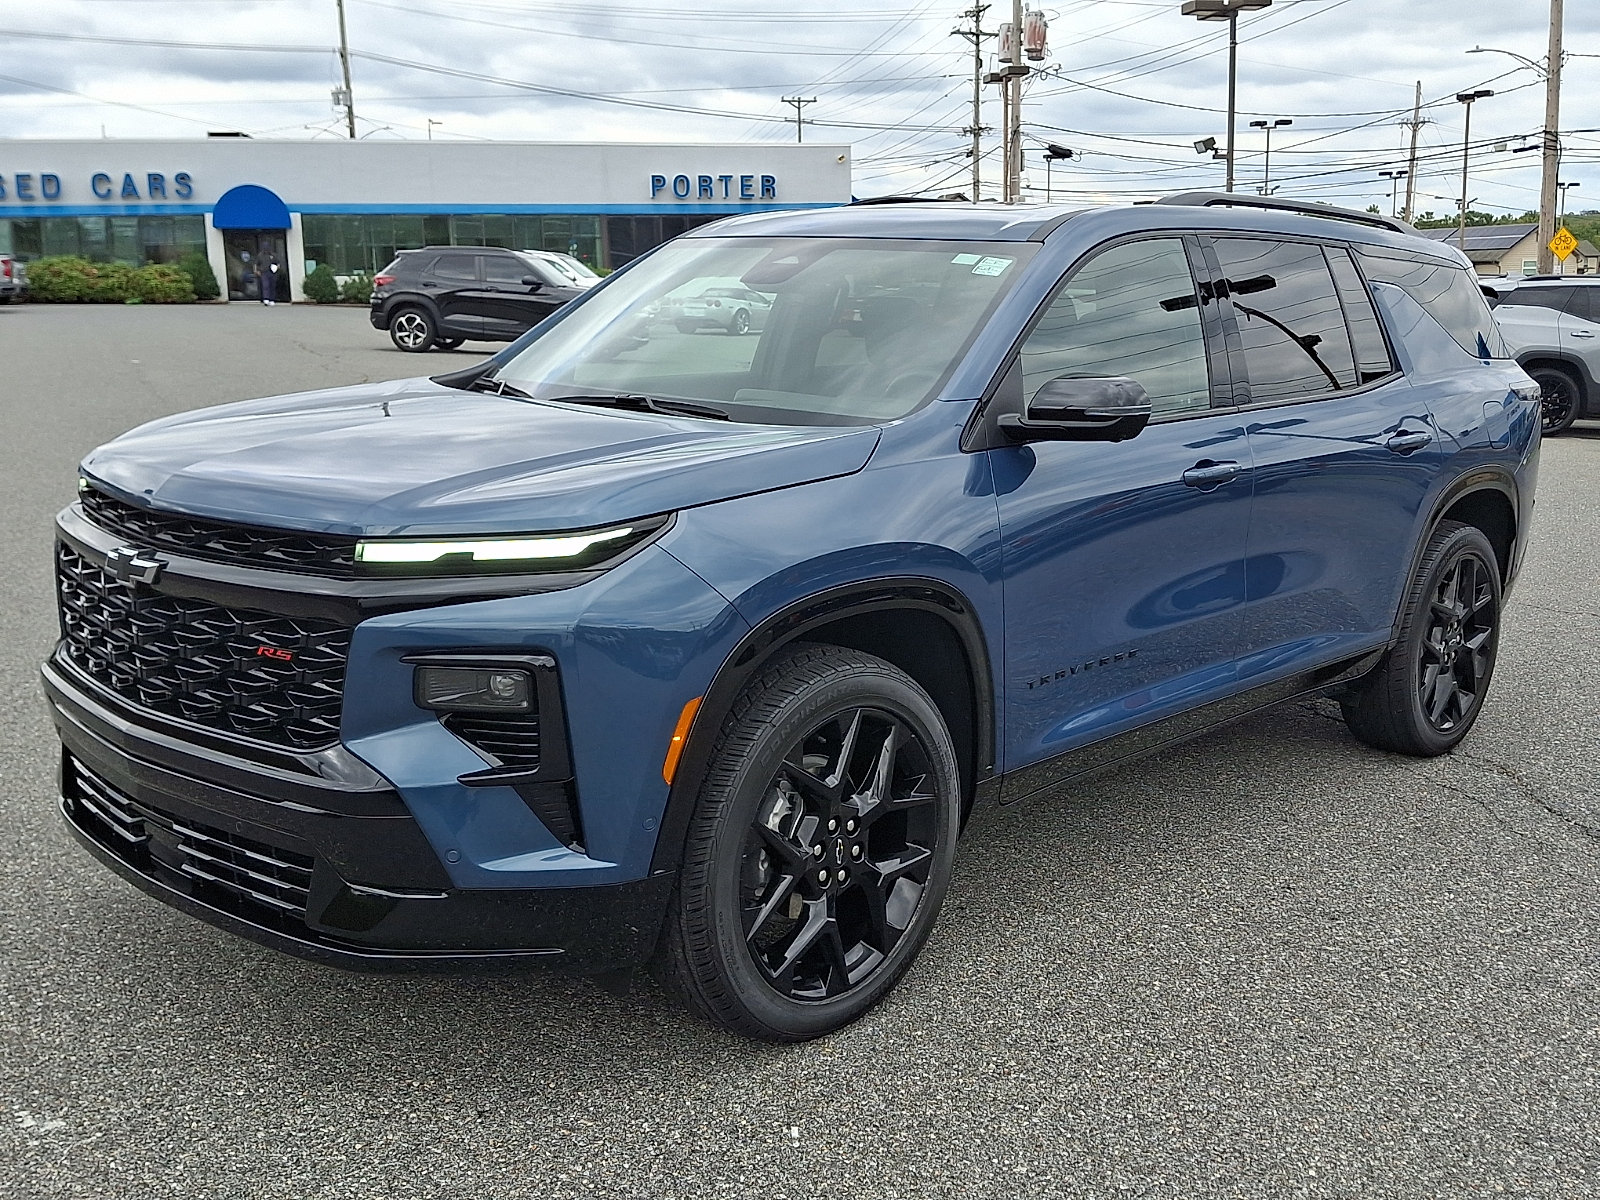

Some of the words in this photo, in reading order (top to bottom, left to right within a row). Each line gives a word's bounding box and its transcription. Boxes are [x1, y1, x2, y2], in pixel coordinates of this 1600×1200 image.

[91, 172, 194, 199] CARS
[650, 174, 777, 199] PORTER
[257, 645, 293, 661] RS
[1026, 648, 1139, 690] TRAVERSE
